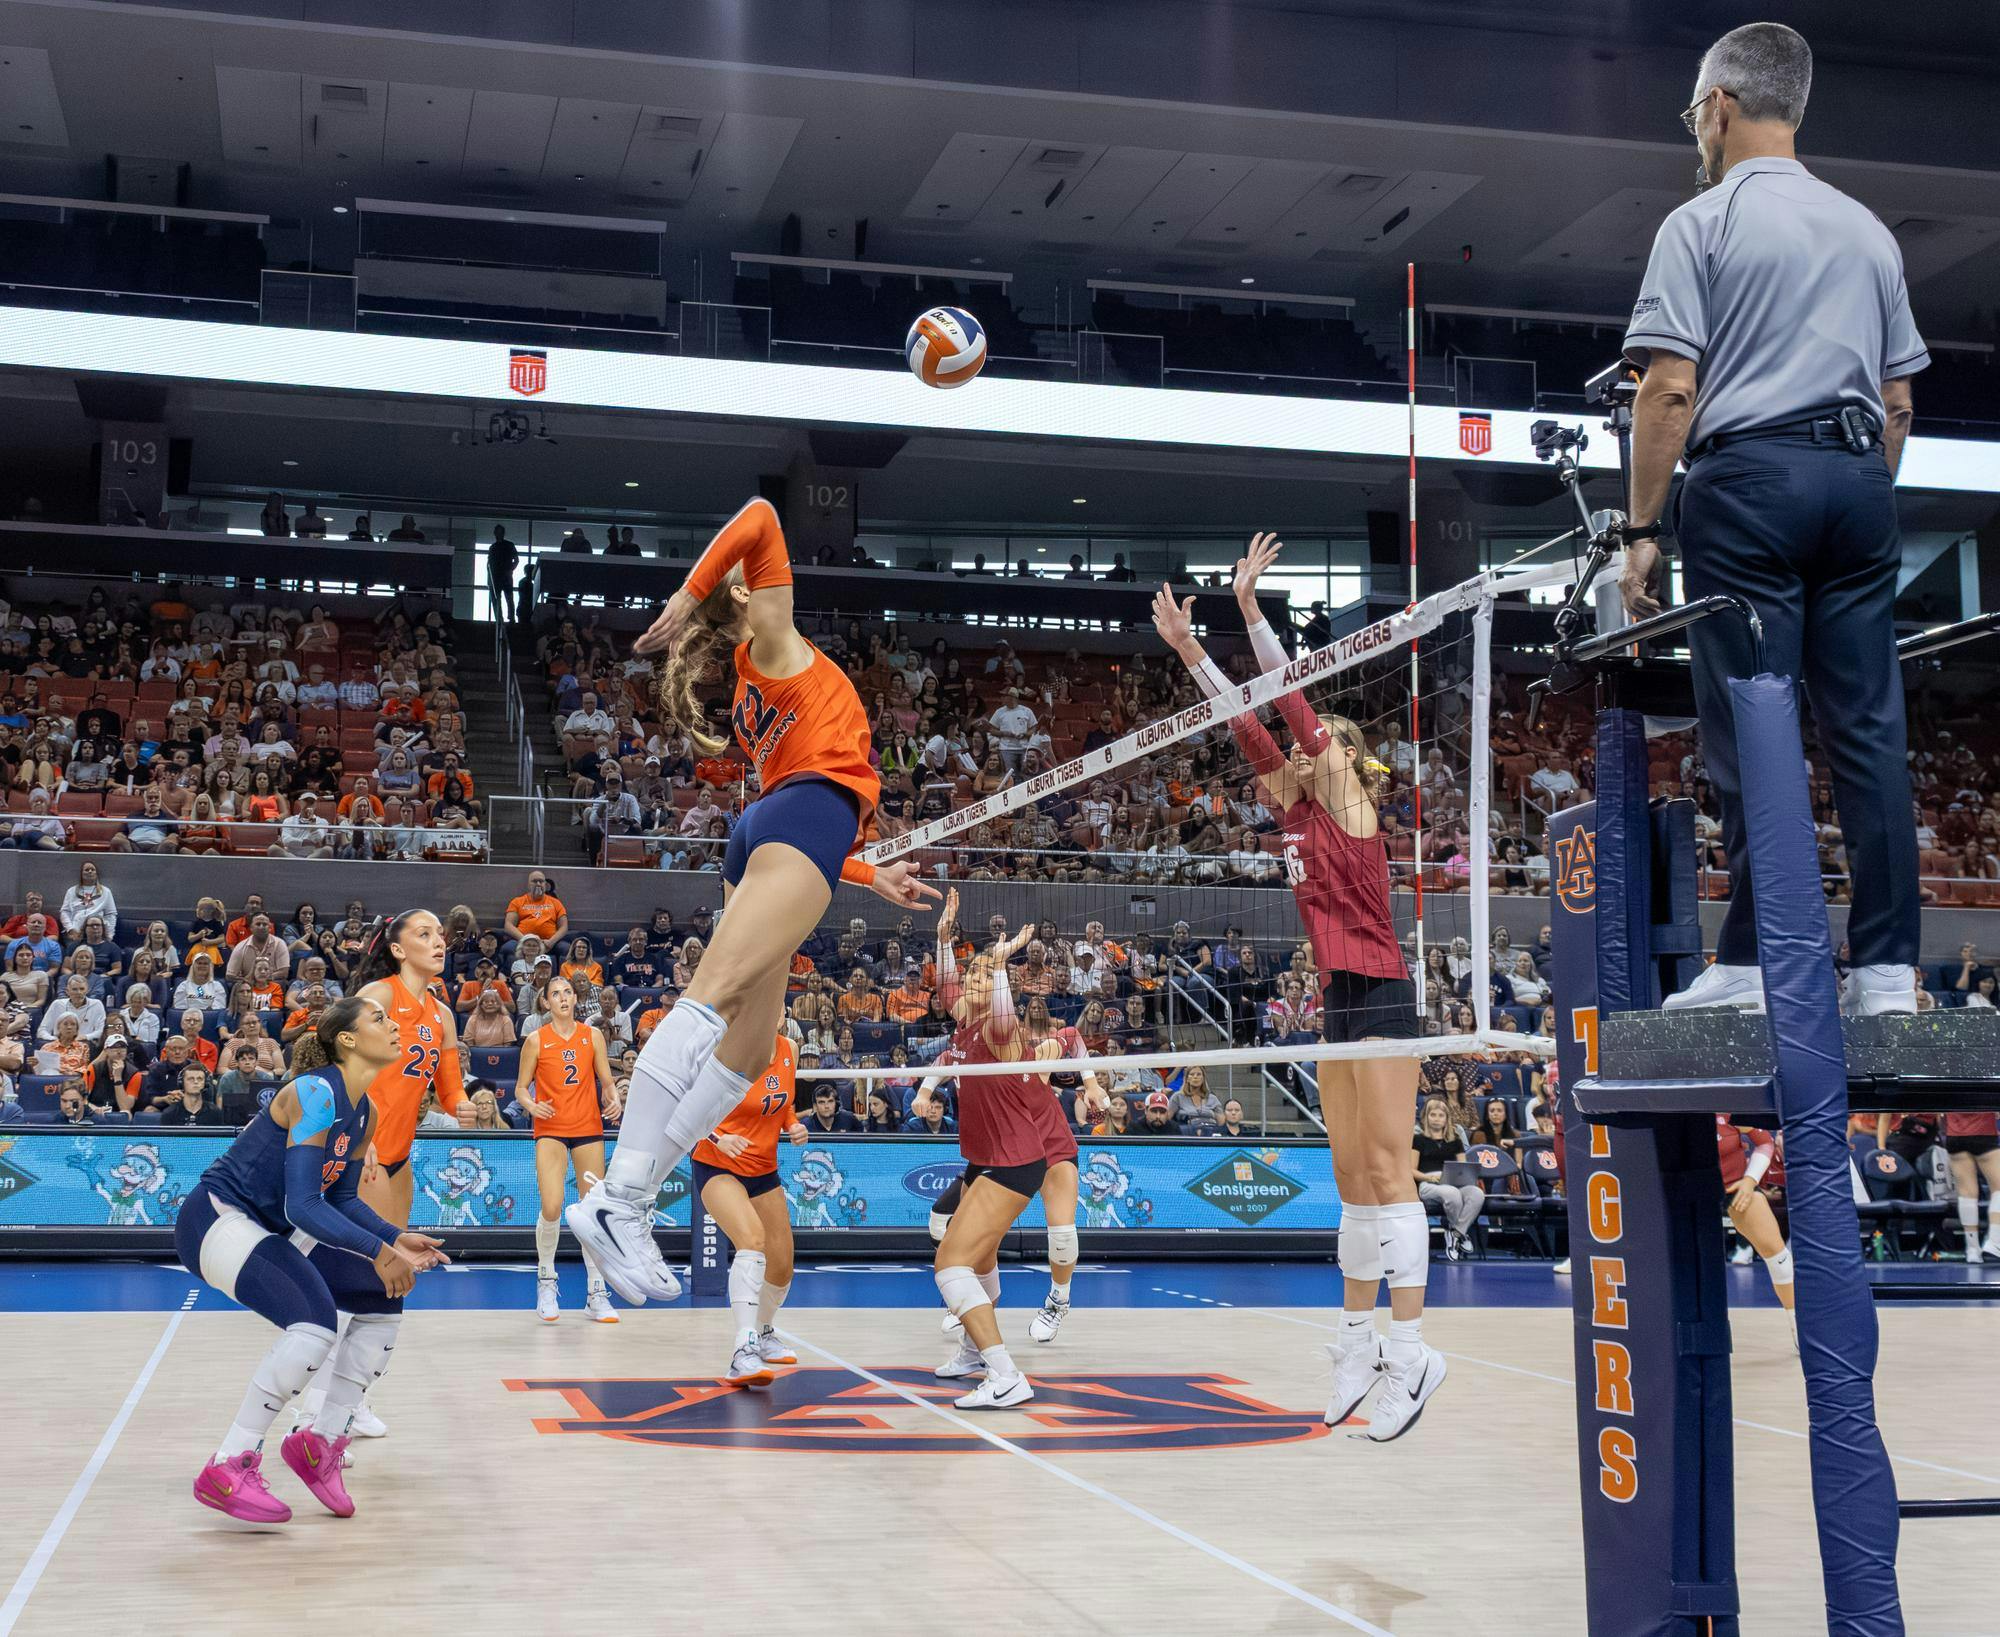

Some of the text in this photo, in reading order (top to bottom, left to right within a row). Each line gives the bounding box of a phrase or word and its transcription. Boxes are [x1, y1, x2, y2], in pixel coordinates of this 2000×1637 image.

[110, 440, 158, 464] 103
[805, 485, 848, 508] 102
[1438, 520, 1472, 541] 101
[1282, 618, 1392, 687] AUBURN TIGERS
[1136, 701, 1213, 751] AUBURN TIGERS
[1026, 759, 1084, 797] AUBURN TIGERS
[942, 813, 965, 833] AUBURN
[966, 802, 988, 824] TIGERS
[402, 1044, 440, 1080] 23
[564, 1064, 580, 1085] 2
[761, 1091, 788, 1116] 17
[320, 1160, 348, 1193] 15
[1203, 1181, 1289, 1200] Sensigreen
[1247, 1204, 1268, 1213] 2007
[703, 1213, 717, 1268] senoh
